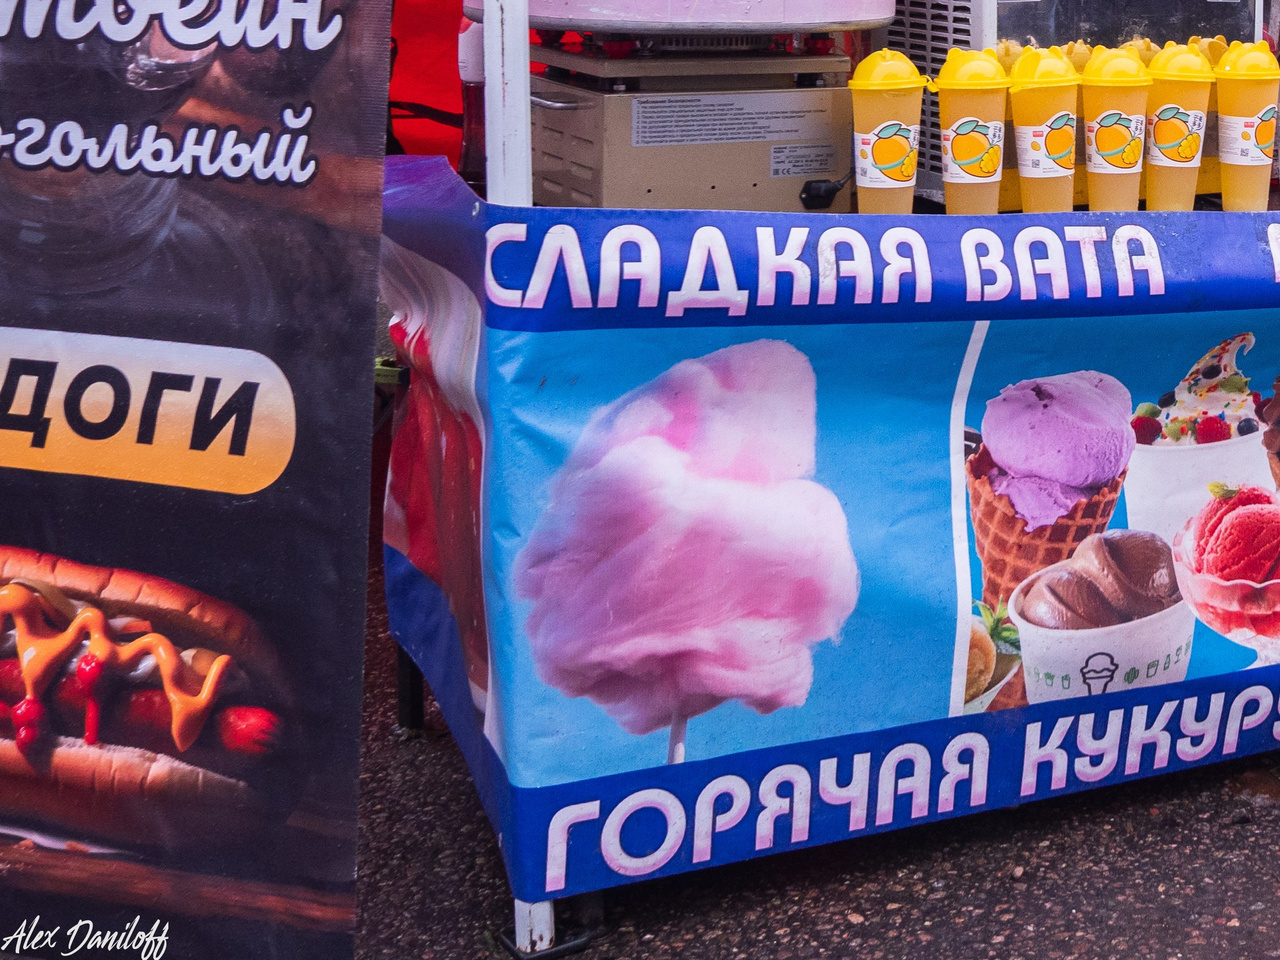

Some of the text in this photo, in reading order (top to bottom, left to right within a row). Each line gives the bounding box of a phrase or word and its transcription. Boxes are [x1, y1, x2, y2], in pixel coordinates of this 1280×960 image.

[0, 106, 316, 183] гольный
[485, 222, 1166, 317] СЛАДКАЯ ВАТА
[0, 358, 260, 456] ДОГИ
[544, 732, 988, 893] ГОРЯЧАЯ
